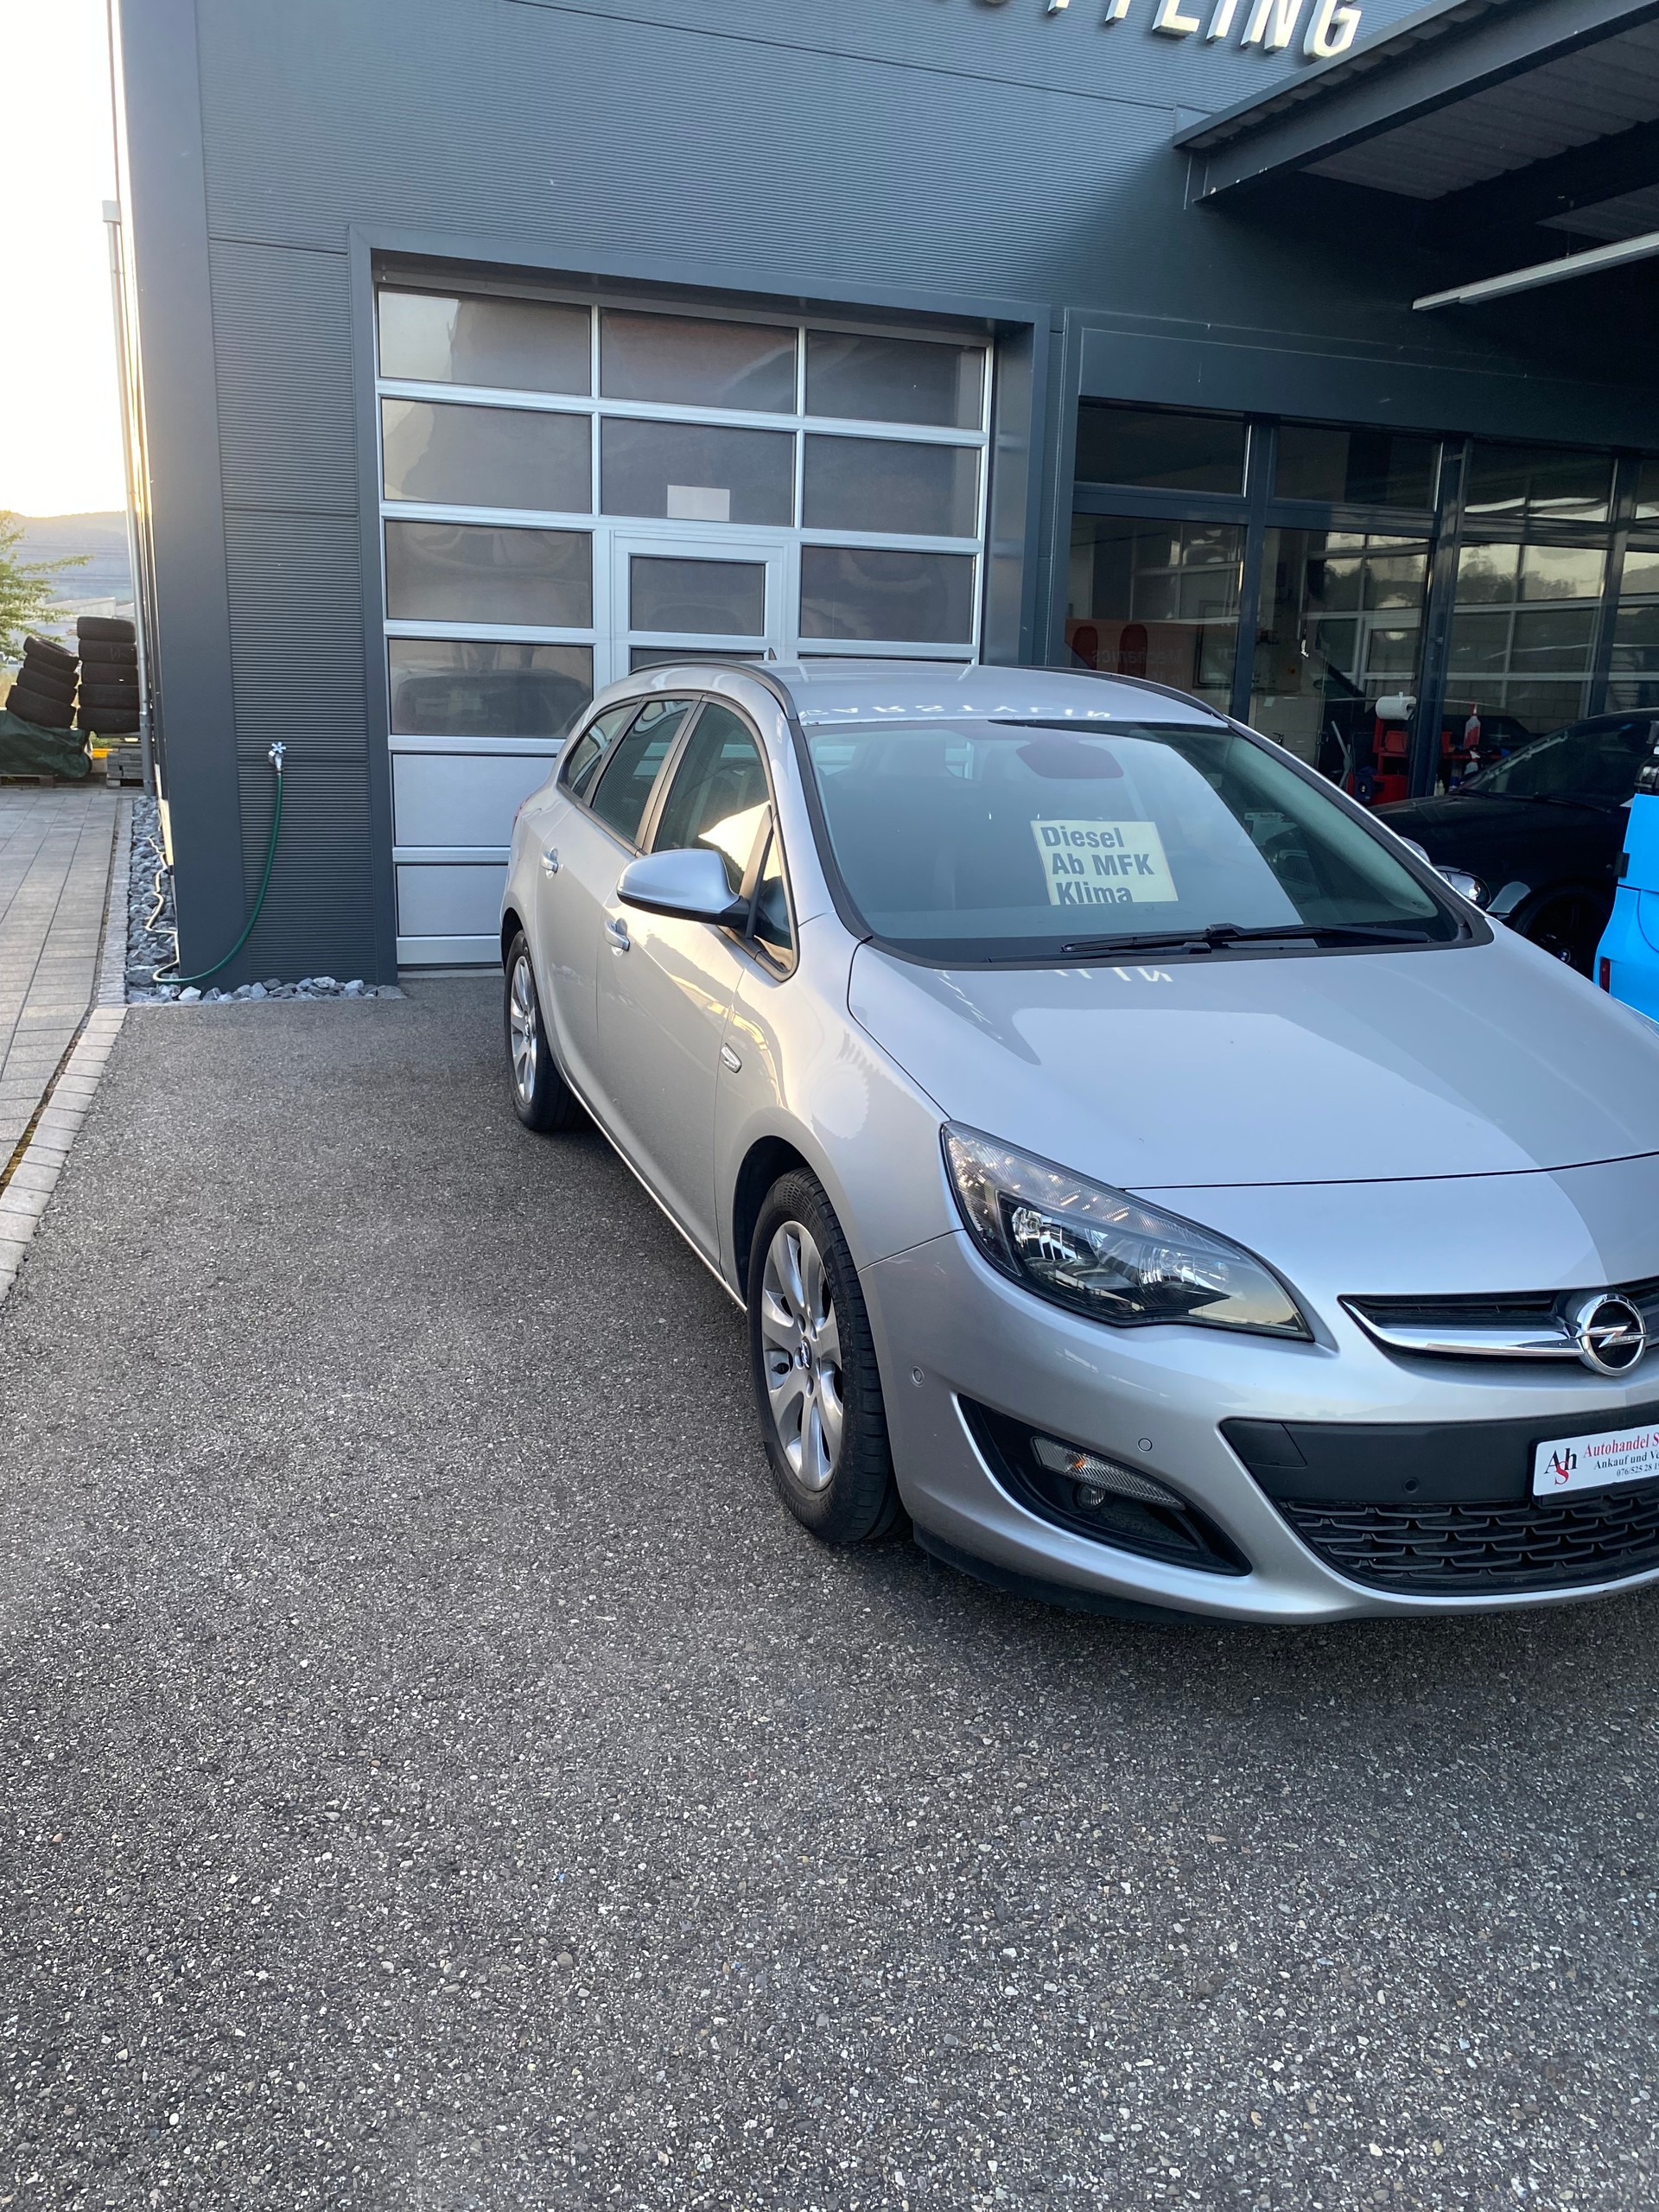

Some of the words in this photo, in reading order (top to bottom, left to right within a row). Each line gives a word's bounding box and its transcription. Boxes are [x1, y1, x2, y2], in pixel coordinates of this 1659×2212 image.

[1040, 826, 1124, 848] Diesel
[1052, 853, 1084, 874] Ab
[1092, 854, 1154, 875] MFK
[1056, 881, 1134, 905] Klima
[1583, 1433, 1649, 1459] Autohandel
[1594, 1454, 1629, 1471] Ankauf
[1630, 1452, 1647, 1464] und
